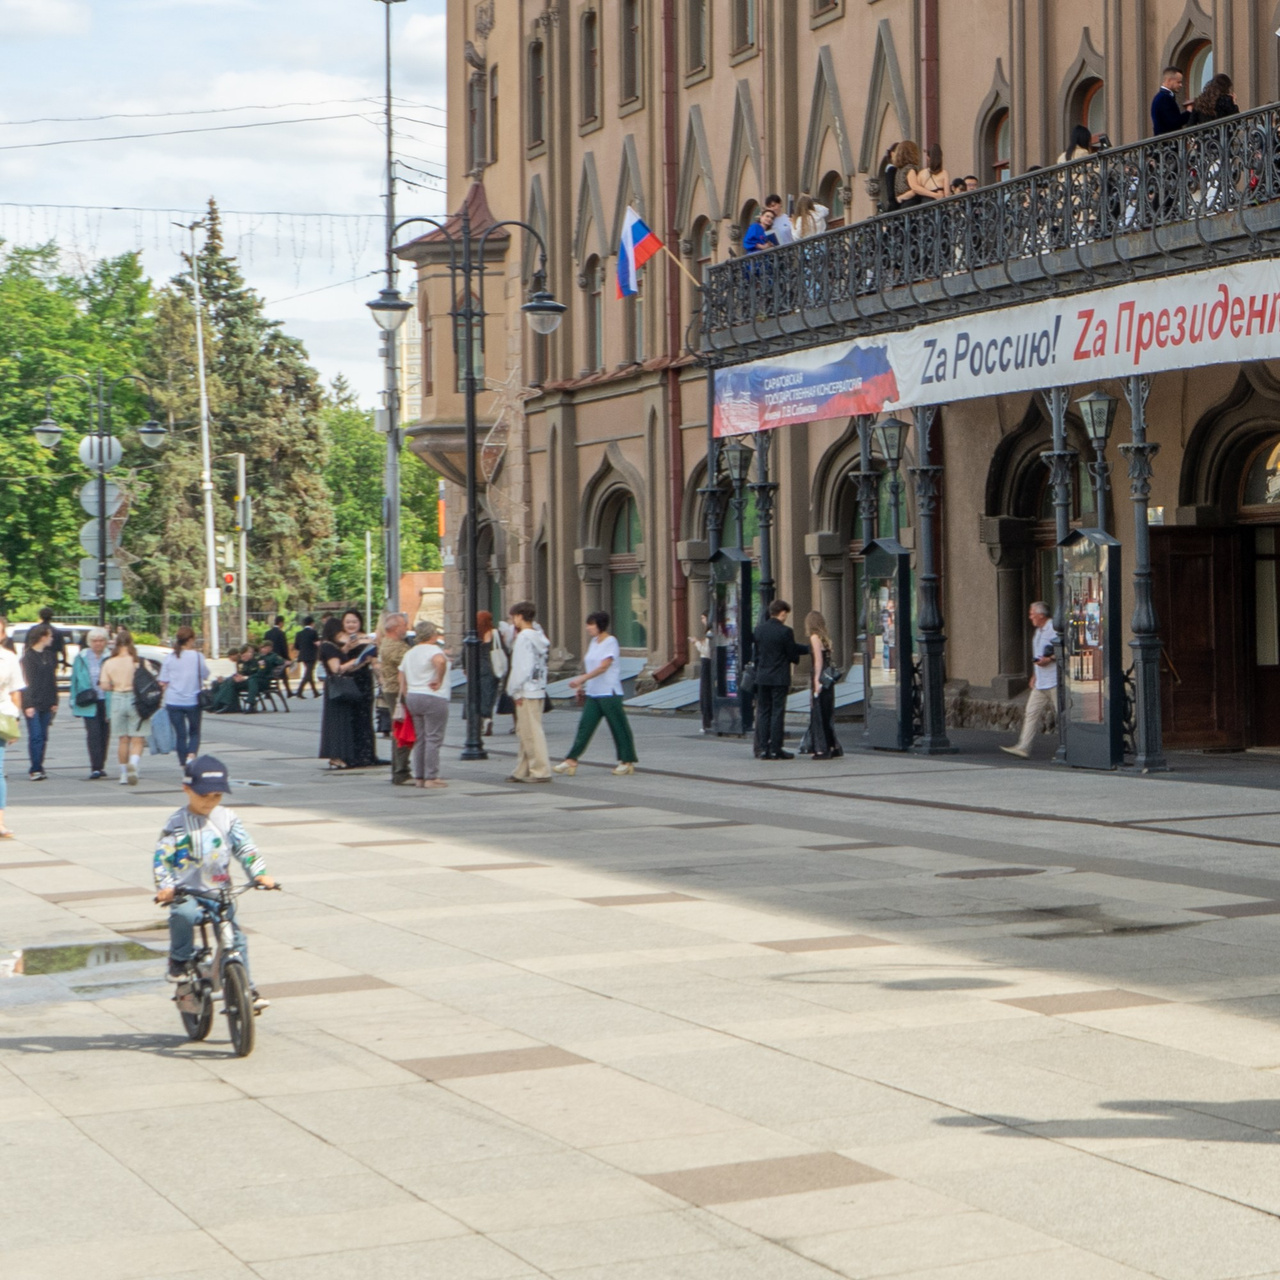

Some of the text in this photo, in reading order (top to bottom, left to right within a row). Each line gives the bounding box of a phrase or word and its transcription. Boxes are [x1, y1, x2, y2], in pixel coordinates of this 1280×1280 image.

[952, 314, 1062, 379] Россию!
[764, 372, 803, 390] САРАТОВСКАЯ
[764, 377, 863, 406] ГОСУДАРСТВЕННАЯ КОНСЕРВАТОРИЯ
